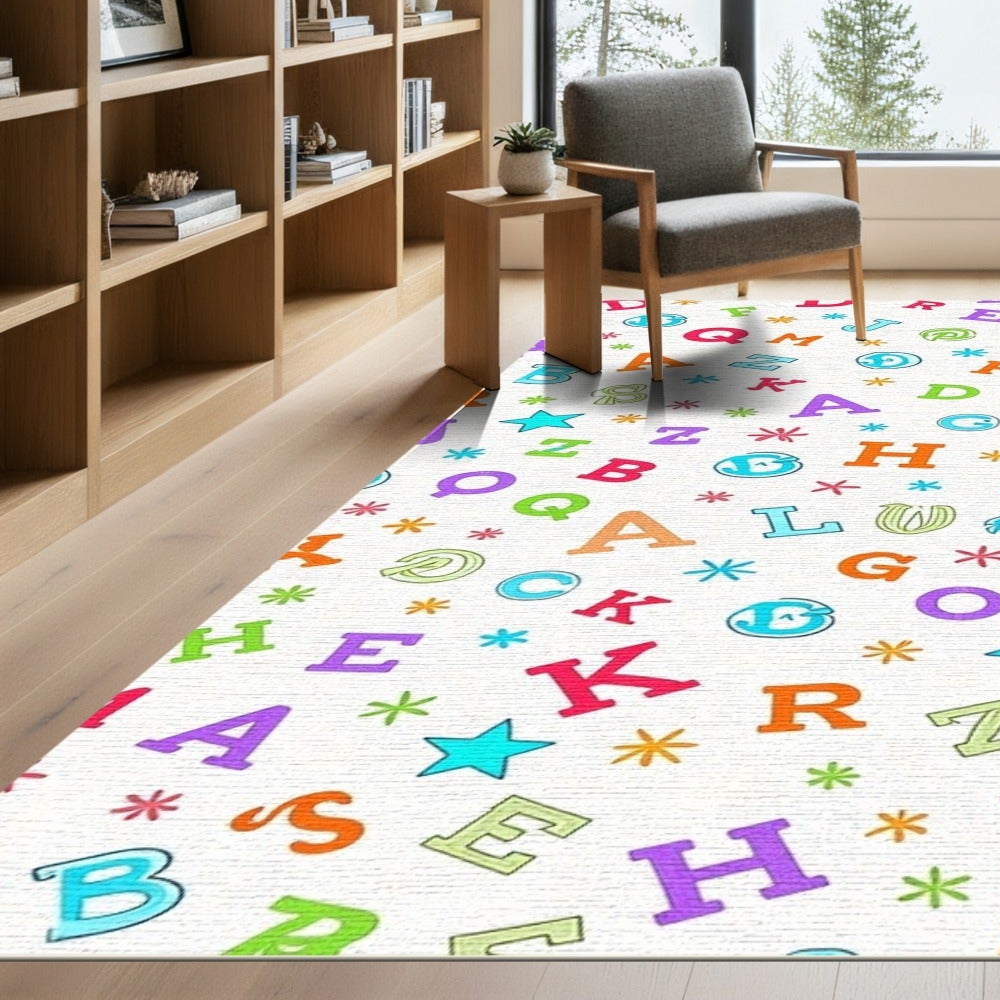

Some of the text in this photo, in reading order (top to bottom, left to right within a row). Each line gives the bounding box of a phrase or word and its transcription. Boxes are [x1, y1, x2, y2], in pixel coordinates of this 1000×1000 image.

[683, 327, 749, 344] Q
[790, 394, 880, 418] A
[917, 384, 981, 400] D
[524, 438, 592, 459] Z
[649, 426, 710, 445] Z
[576, 458, 657, 484] B
[843, 441, 946, 470] H
[512, 492, 591, 522] Q
[751, 505, 843, 539] L
[567, 510, 697, 556] A
[837, 552, 918, 582] G
[496, 570, 581, 600] C
[571, 589, 672, 626] K
[170, 619, 275, 664] H
[306, 632, 424, 673] E
[526, 640, 701, 719] K
[757, 682, 867, 734] R
[137, 705, 292, 771] A
[420, 795, 593, 876] E
[630, 818, 829, 926] H
[32, 847, 186, 942] B
